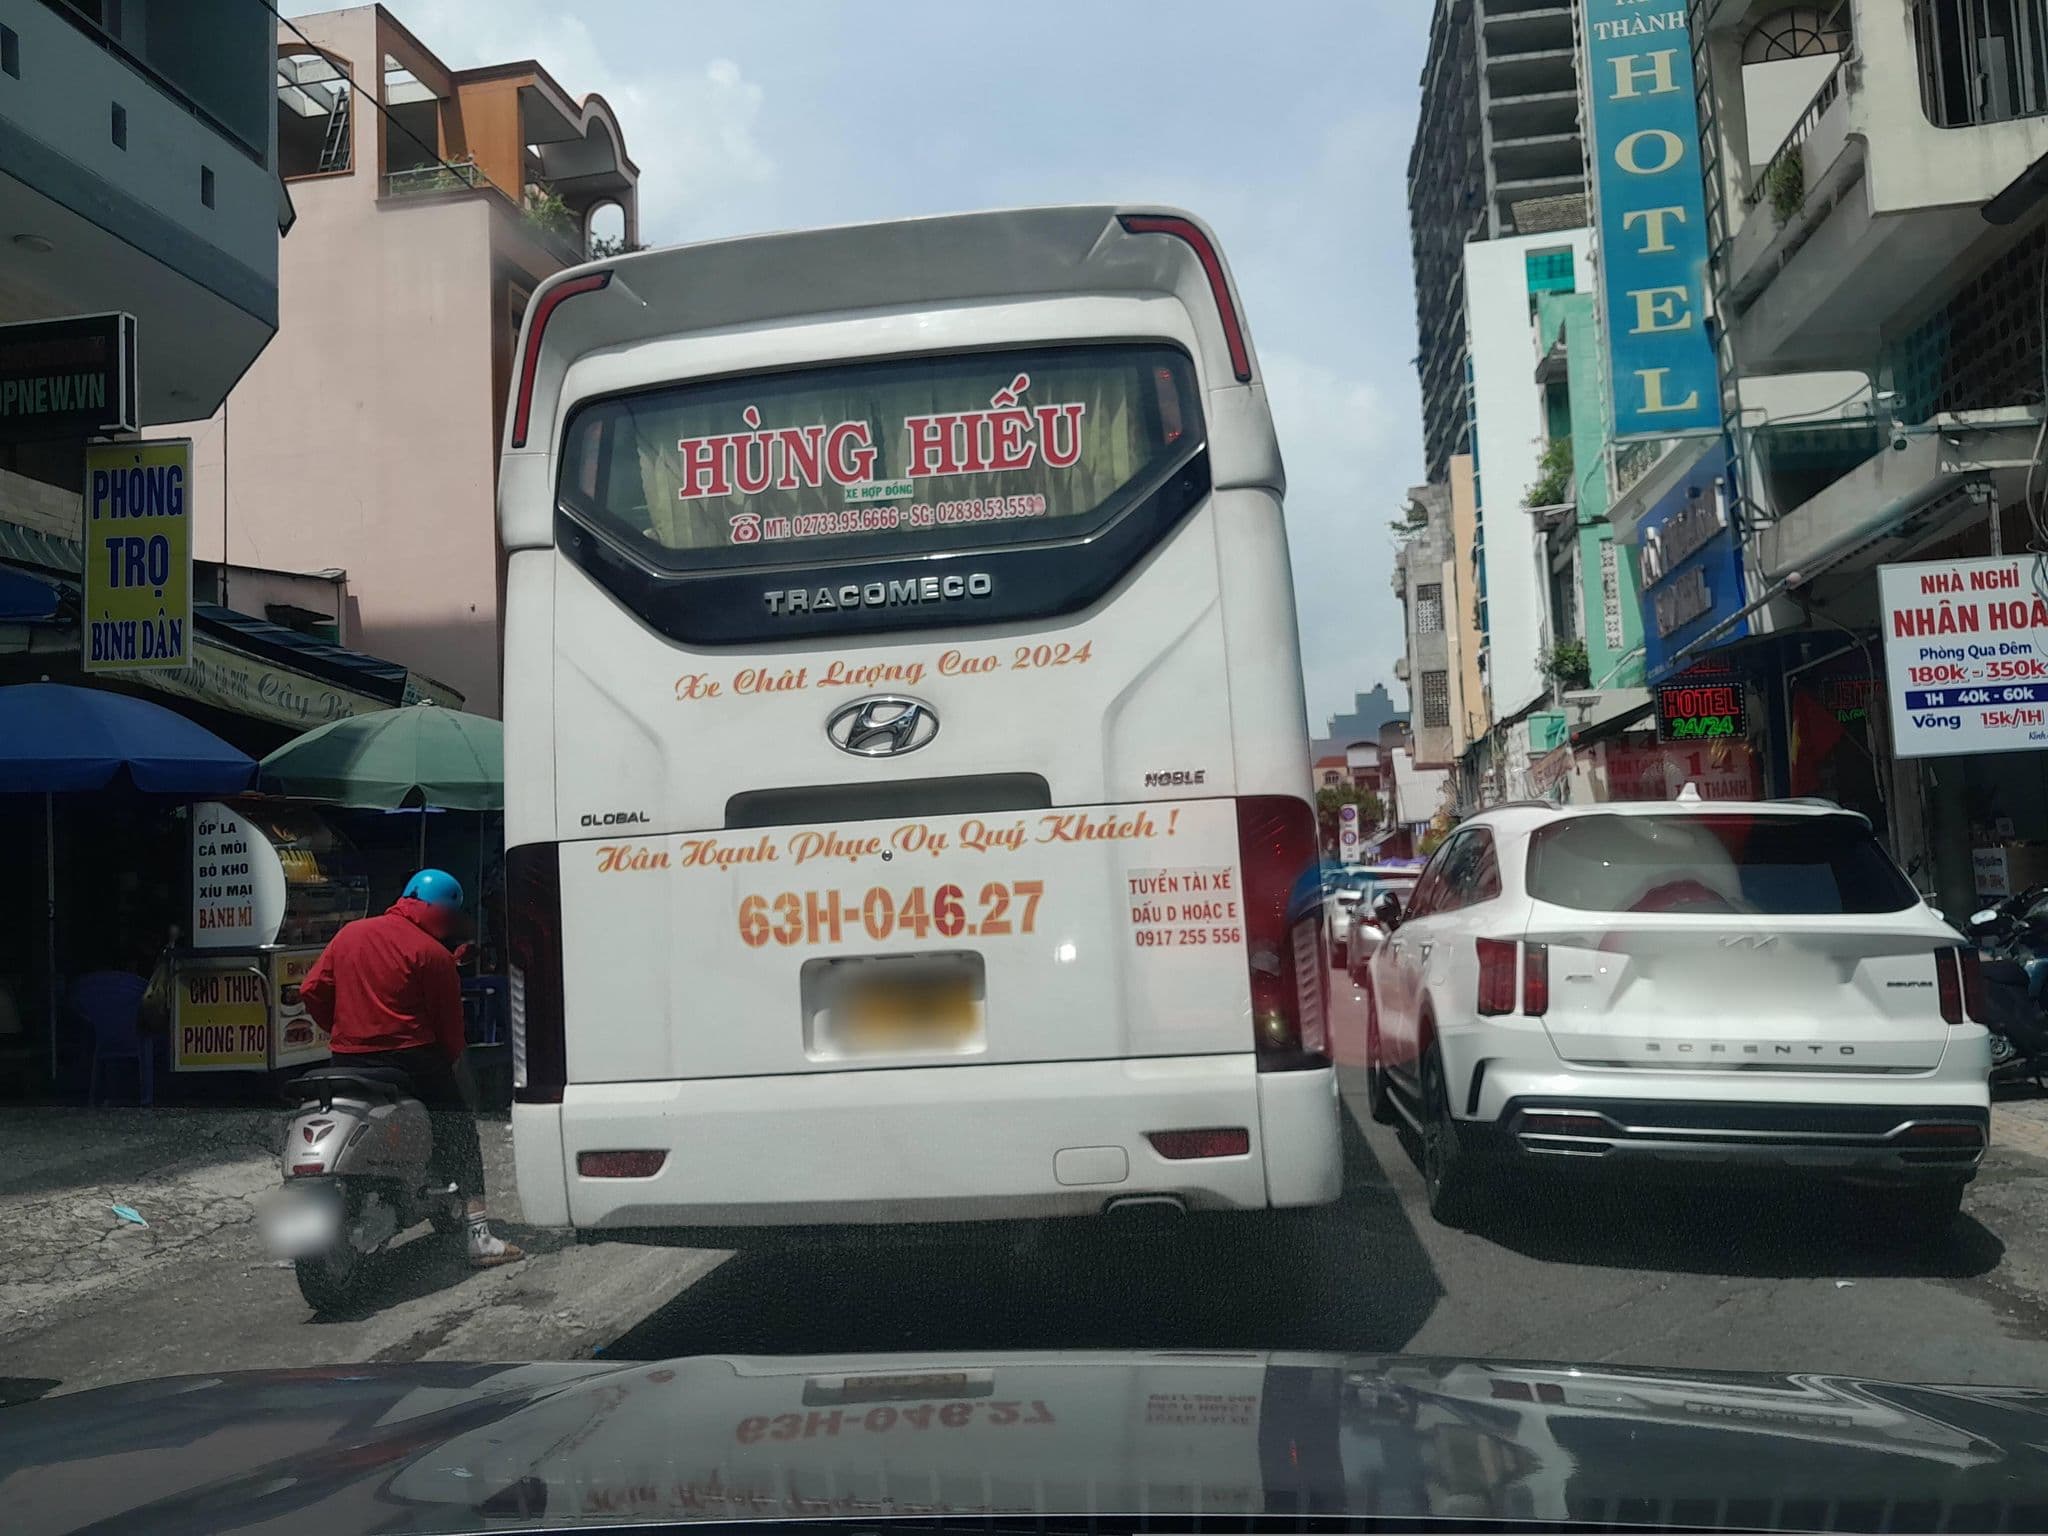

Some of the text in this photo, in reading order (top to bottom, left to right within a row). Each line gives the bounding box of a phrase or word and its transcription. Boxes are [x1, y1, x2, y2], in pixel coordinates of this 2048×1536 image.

[1593, 10, 1686, 40] THÀNH
[1606, 47, 1698, 414] HOTEL
[0, 373, 105, 416] PNEW.VN
[679, 373, 1085, 500] HÙNG HIẾU
[92, 455, 183, 519] PHÒNG
[845, 482, 913, 498] XE HỢP ĐỒNG
[764, 518, 791, 540] MT:
[793, 507, 899, 537] 02733.95.6666
[911, 505, 935, 527] SG:
[106, 534, 169, 597] TRỌ
[1920, 562, 2020, 595] NHÀ NGHỈ
[764, 573, 992, 615] TRACOMECO
[1893, 599, 1980, 638] NHÂN
[91, 608, 183, 661] BÌNH DÂN
[1919, 641, 2032, 662] Phòng Qua Đêm
[675, 673, 723, 701] Xe
[816, 660, 926, 689] Lượng
[938, 649, 1001, 677] Cao
[1011, 640, 1093, 670] 2024
[1908, 664, 1968, 685] 180k
[1986, 659, 2048, 680] 350k
[1663, 687, 1740, 718] HOTEL
[1925, 692, 1945, 707] 1H
[1957, 690, 1990, 705] 40k
[2003, 687, 2035, 702] 60k
[1672, 715, 1735, 738] 24/24
[1912, 709, 2046, 730] Võng 15k/1H
[1144, 769, 1206, 788] NOBLE
[221, 823, 237, 834] LA
[580, 811, 651, 827] GLOBAL
[221, 841, 247, 855] MÒI
[596, 846, 671, 873] Hân
[680, 835, 779, 871] Hạnh
[788, 830, 884, 865] Phục
[890, 823, 949, 857] Vụ
[958, 817, 1030, 853] Quý
[1035, 810, 1157, 844] Khách
[199, 863, 249, 877] BÒ KHO
[1128, 866, 1233, 895] TUYỂN TÀI XẾ
[199, 884, 253, 898] XÍU MẠI
[199, 901, 253, 929] BÁNH MÌ
[738, 880, 1044, 949] 63H-046.27
[1132, 900, 1237, 924] DẤU D HOẶC E
[1136, 927, 1241, 946] 0917 255 556
[189, 976, 220, 1004] CHO
[184, 1018, 265, 1058] PHÒNG TRỌ
[1645, 1042, 1856, 1055] SORENTO
